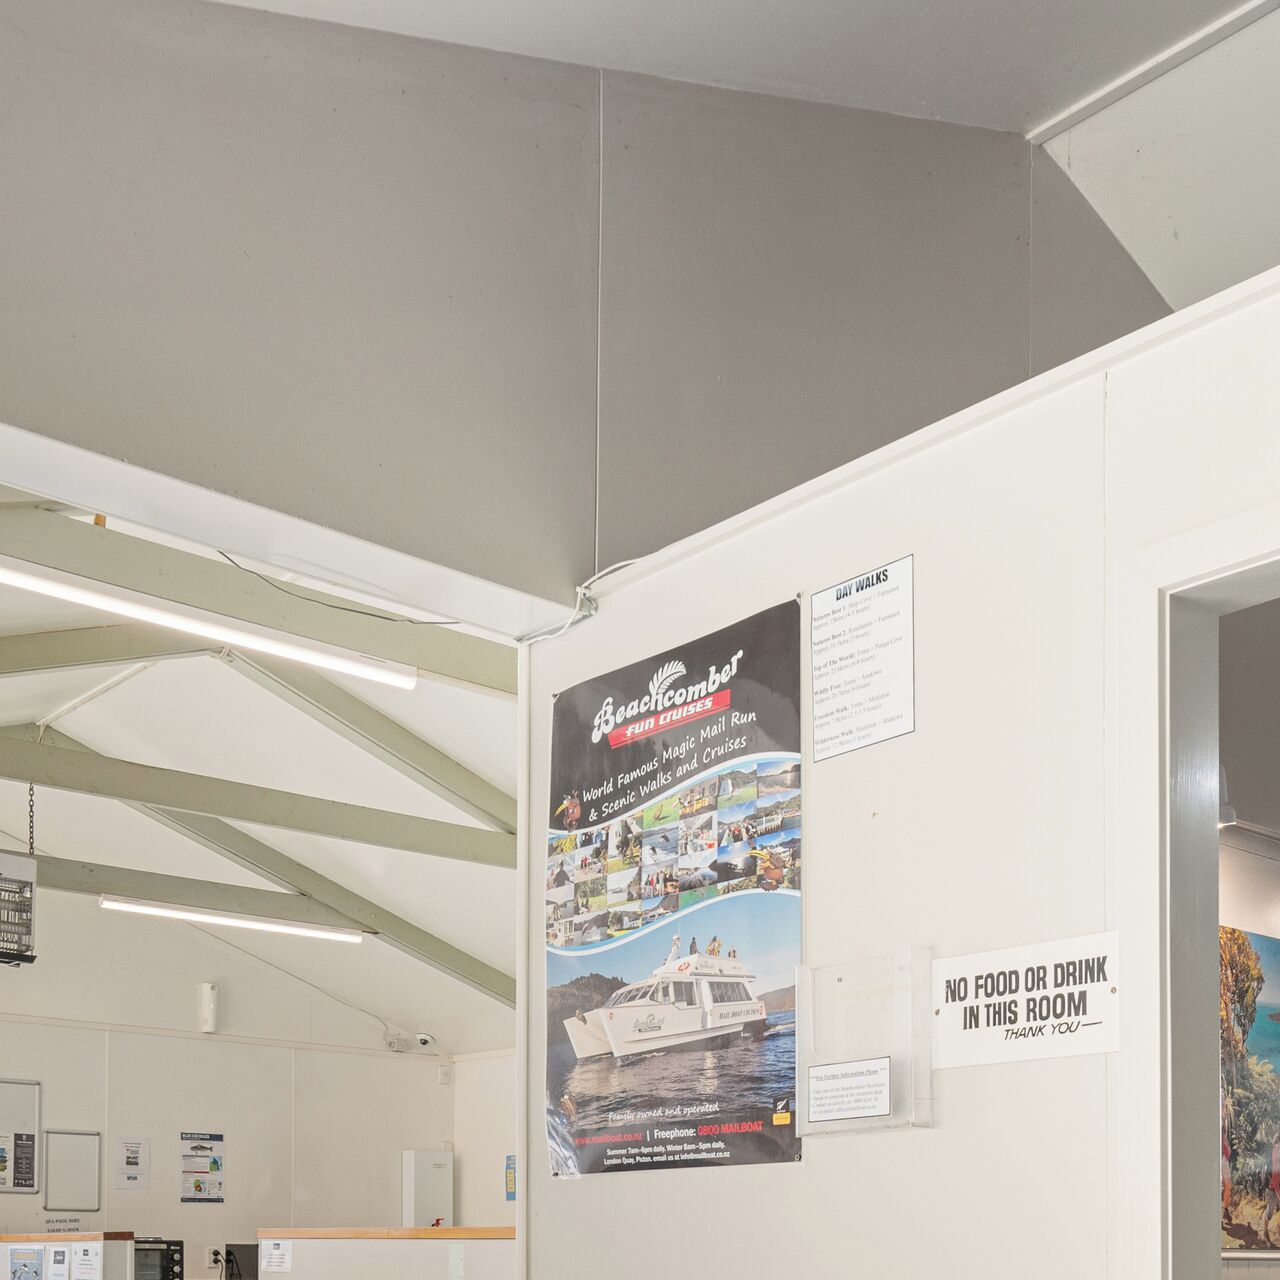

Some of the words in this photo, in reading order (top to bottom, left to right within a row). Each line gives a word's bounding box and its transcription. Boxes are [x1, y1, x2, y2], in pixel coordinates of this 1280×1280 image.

[836, 582, 852, 600] DAY
[856, 568, 888, 593] WALKS
[592, 650, 743, 744] Beachcomber
[626, 717, 656, 737] FUN
[659, 696, 714, 726] CRUISES
[582, 781, 614, 802] World
[617, 758, 658, 788] Famous
[662, 736, 696, 764] Magic
[700, 718, 726, 743] Mail
[731, 711, 756, 727] Run
[588, 808, 598, 822] &
[602, 791, 636, 816] Scenic
[640, 770, 672, 797] Walks
[676, 756, 698, 778] and
[702, 736, 747, 764] Cruises
[945, 977, 968, 1004] NO
[974, 970, 1020, 999] FOOD
[1024, 965, 1048, 992] OR
[1054, 955, 1108, 988] DRINK
[963, 1004, 980, 1030] IN
[984, 1000, 1018, 1027] THIS
[1026, 990, 1087, 1022] ROOM
[1004, 1024, 1046, 1040] THANK
[1052, 1020, 1080, 1034] YOU
[608, 1110, 634, 1120] Family
[636, 1107, 663, 1118] owned
[664, 1105, 682, 1114] and
[684, 1102, 720, 1115] operated
[654, 1128, 696, 1140] Freephone:
[698, 1124, 720, 1136] 0800
[721, 1120, 763, 1134] MAILBOAT
